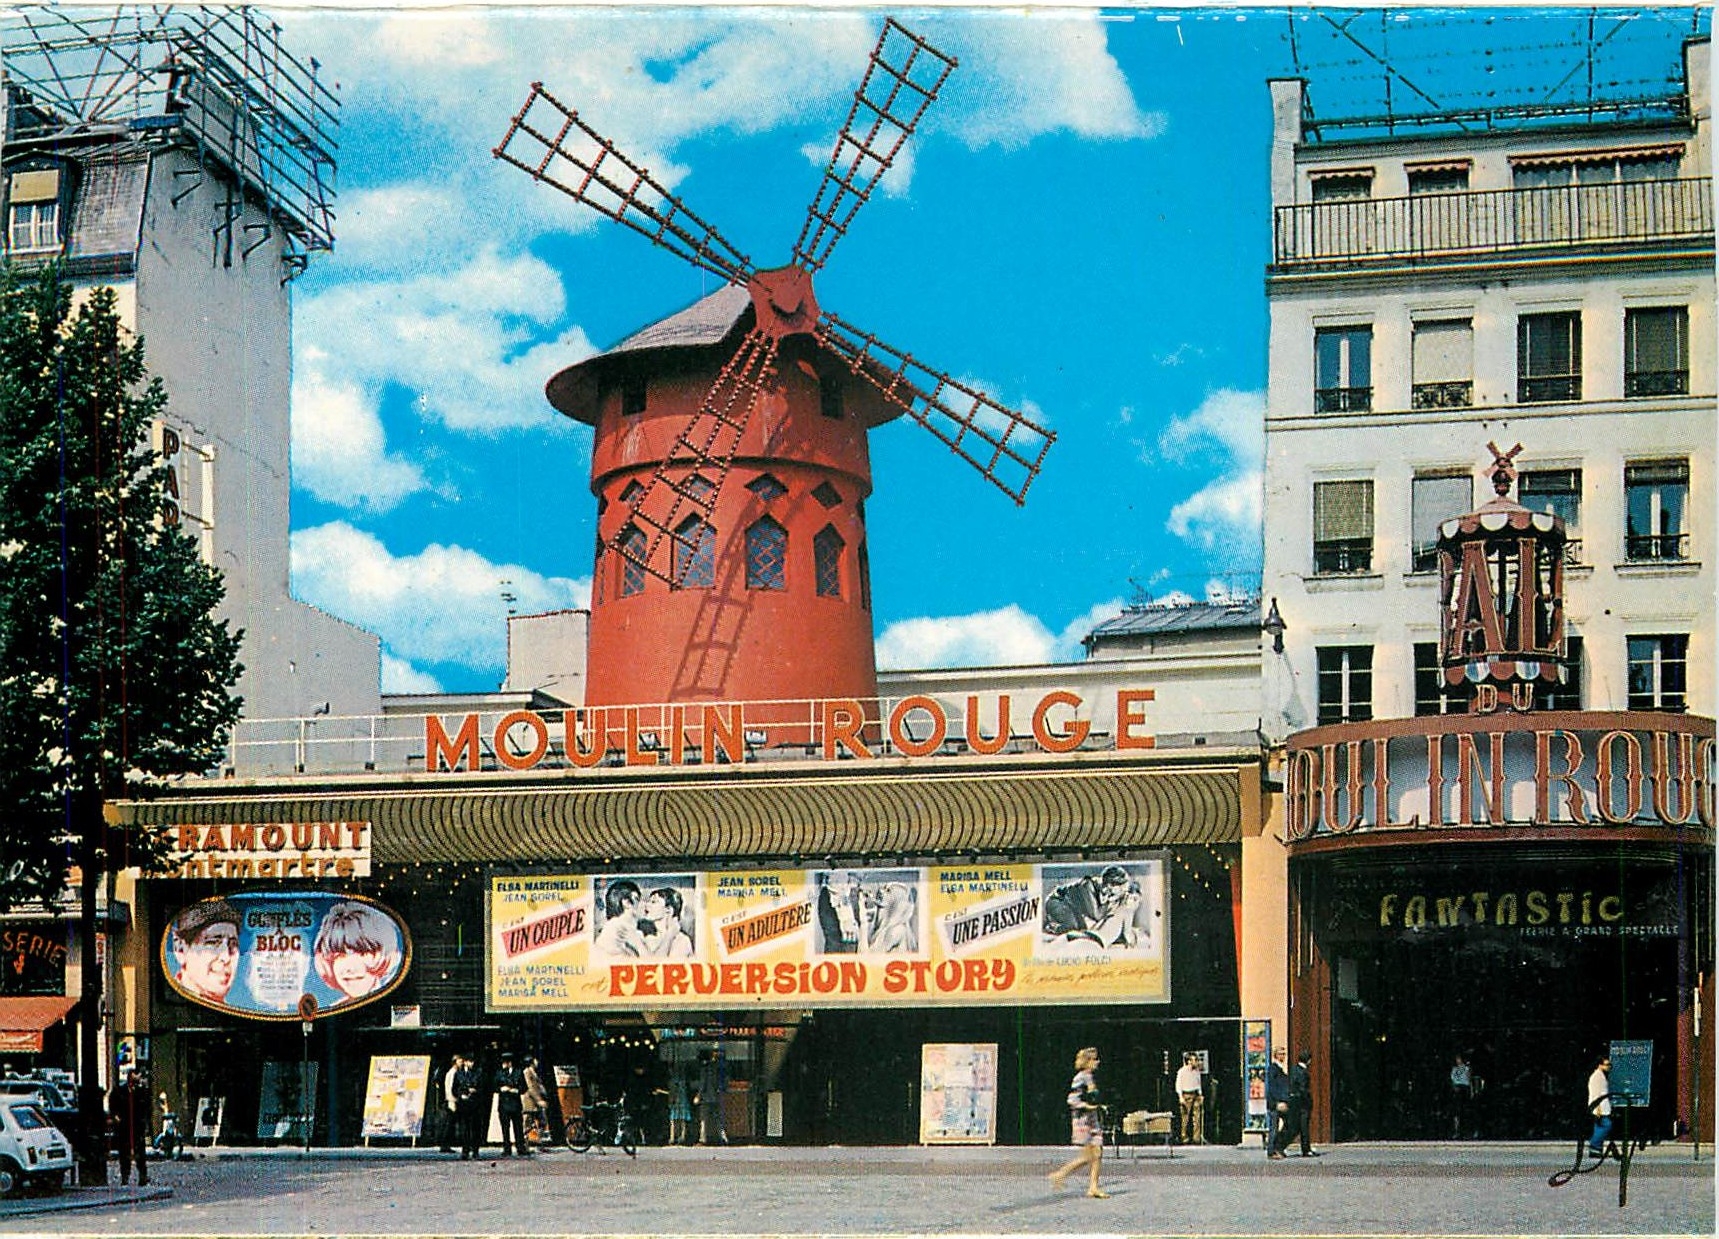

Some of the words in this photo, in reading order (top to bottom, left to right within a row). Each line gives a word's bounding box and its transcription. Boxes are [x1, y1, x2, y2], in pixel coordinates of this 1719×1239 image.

[1478, 683, 1534, 713] DU
[425, 704, 745, 773] MOULIN
[822, 689, 1156, 761] ROUGE
[1288, 731, 1506, 840] OULIN
[150, 822, 368, 852] RAMOUNT
[718, 877, 744, 887] JEAN
[748, 875, 782, 886] SOREL
[940, 871, 979, 881] MARISA
[984, 870, 1012, 880] MELL
[524, 881, 580, 891] MARTINELLI
[968, 881, 1029, 892] MARTINELLI
[503, 893, 527, 902] JEAN
[728, 925, 746, 950] UN
[747, 901, 813, 944] ADULTERE
[952, 917, 980, 945] UNE
[981, 896, 1041, 937] PASSION
[510, 925, 531, 953] UN
[532, 908, 586, 946] COUPLE
[1575, 926, 1612, 936] GRAND
[1617, 924, 1680, 936] SPECTACLE
[256, 935, 302, 952] BLOC
[525, 964, 586, 976] MARTINELLI
[882, 958, 1017, 994] STORY
[531, 976, 567, 987] SOREL
[541, 987, 569, 998] MELL
